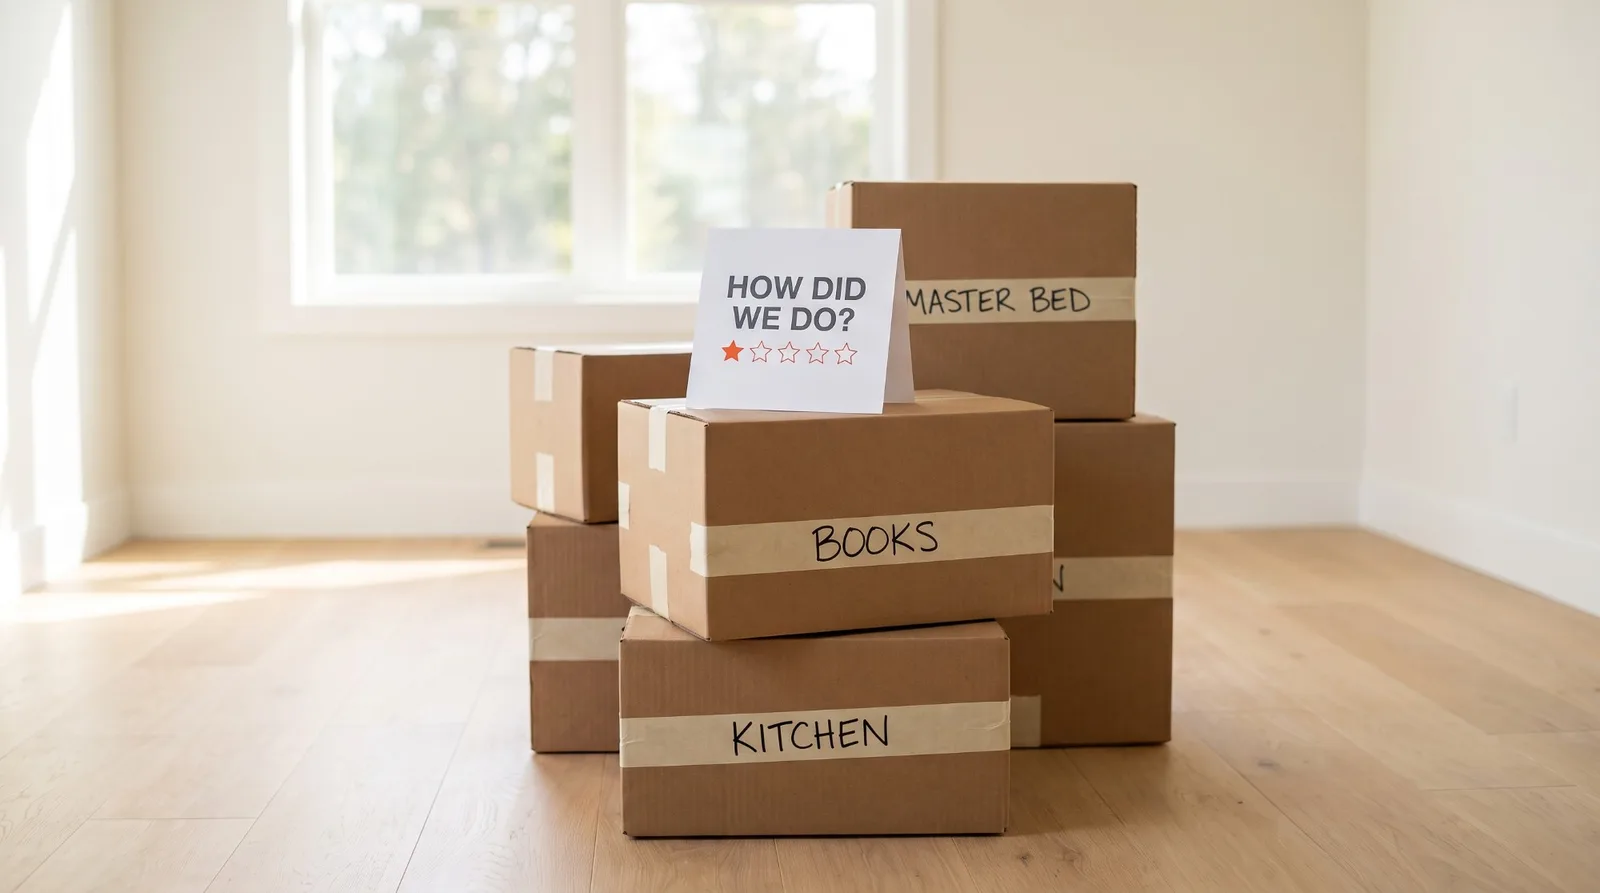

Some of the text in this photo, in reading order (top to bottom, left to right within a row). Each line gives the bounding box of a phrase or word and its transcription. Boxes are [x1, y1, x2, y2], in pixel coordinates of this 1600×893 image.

[727, 275, 867, 301] HOW DID
[906, 286, 1091, 315] MASTER BED
[733, 306, 855, 332] WE DO?
[812, 520, 938, 562] BOOKS
[733, 714, 889, 756] KITCHEN
